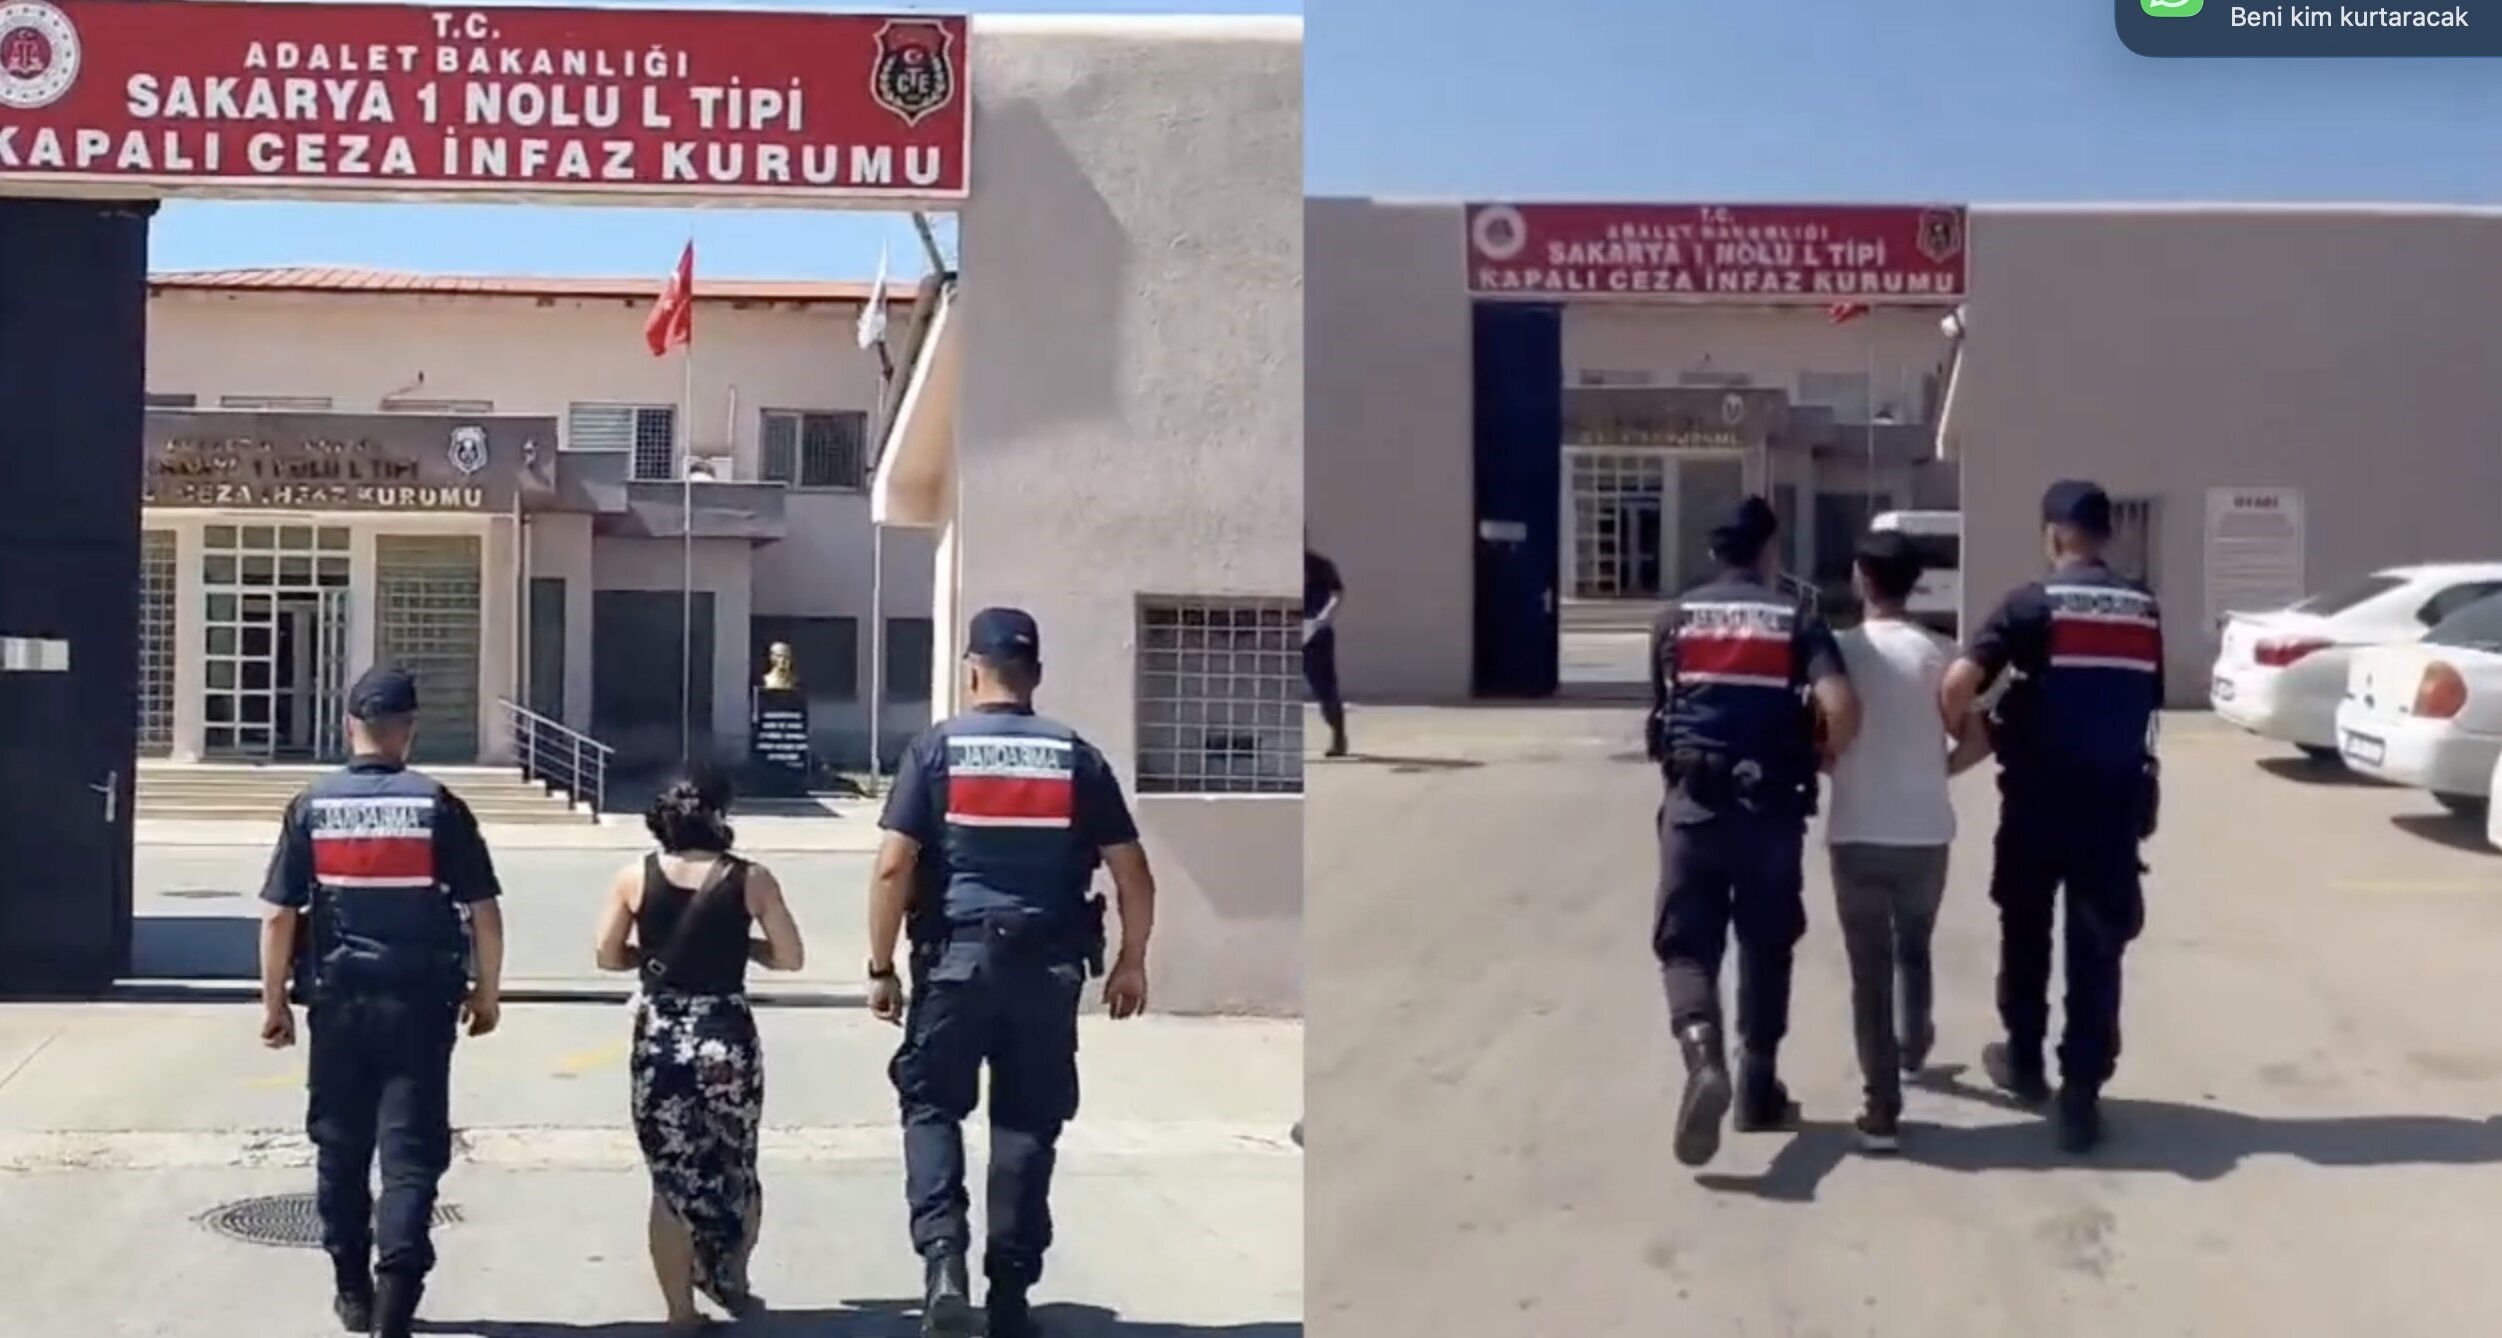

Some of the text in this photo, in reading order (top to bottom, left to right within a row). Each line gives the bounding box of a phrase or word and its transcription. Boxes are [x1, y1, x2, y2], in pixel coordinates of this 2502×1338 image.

[433, 12, 501, 39] T.C.
[243, 41, 688, 78] ADALET BAKANLIĞI
[126, 73, 803, 131] SAKARYA 1 NOLU L TİPİ
[247, 131, 417, 175] CEZA
[444, 126, 634, 178] İNFAZ
[661, 141, 940, 184] KURUMU
[1547, 240, 1682, 266] SAKARYA
[1479, 265, 1954, 293] KAPALI CEZA İNFAZ KURUMU
